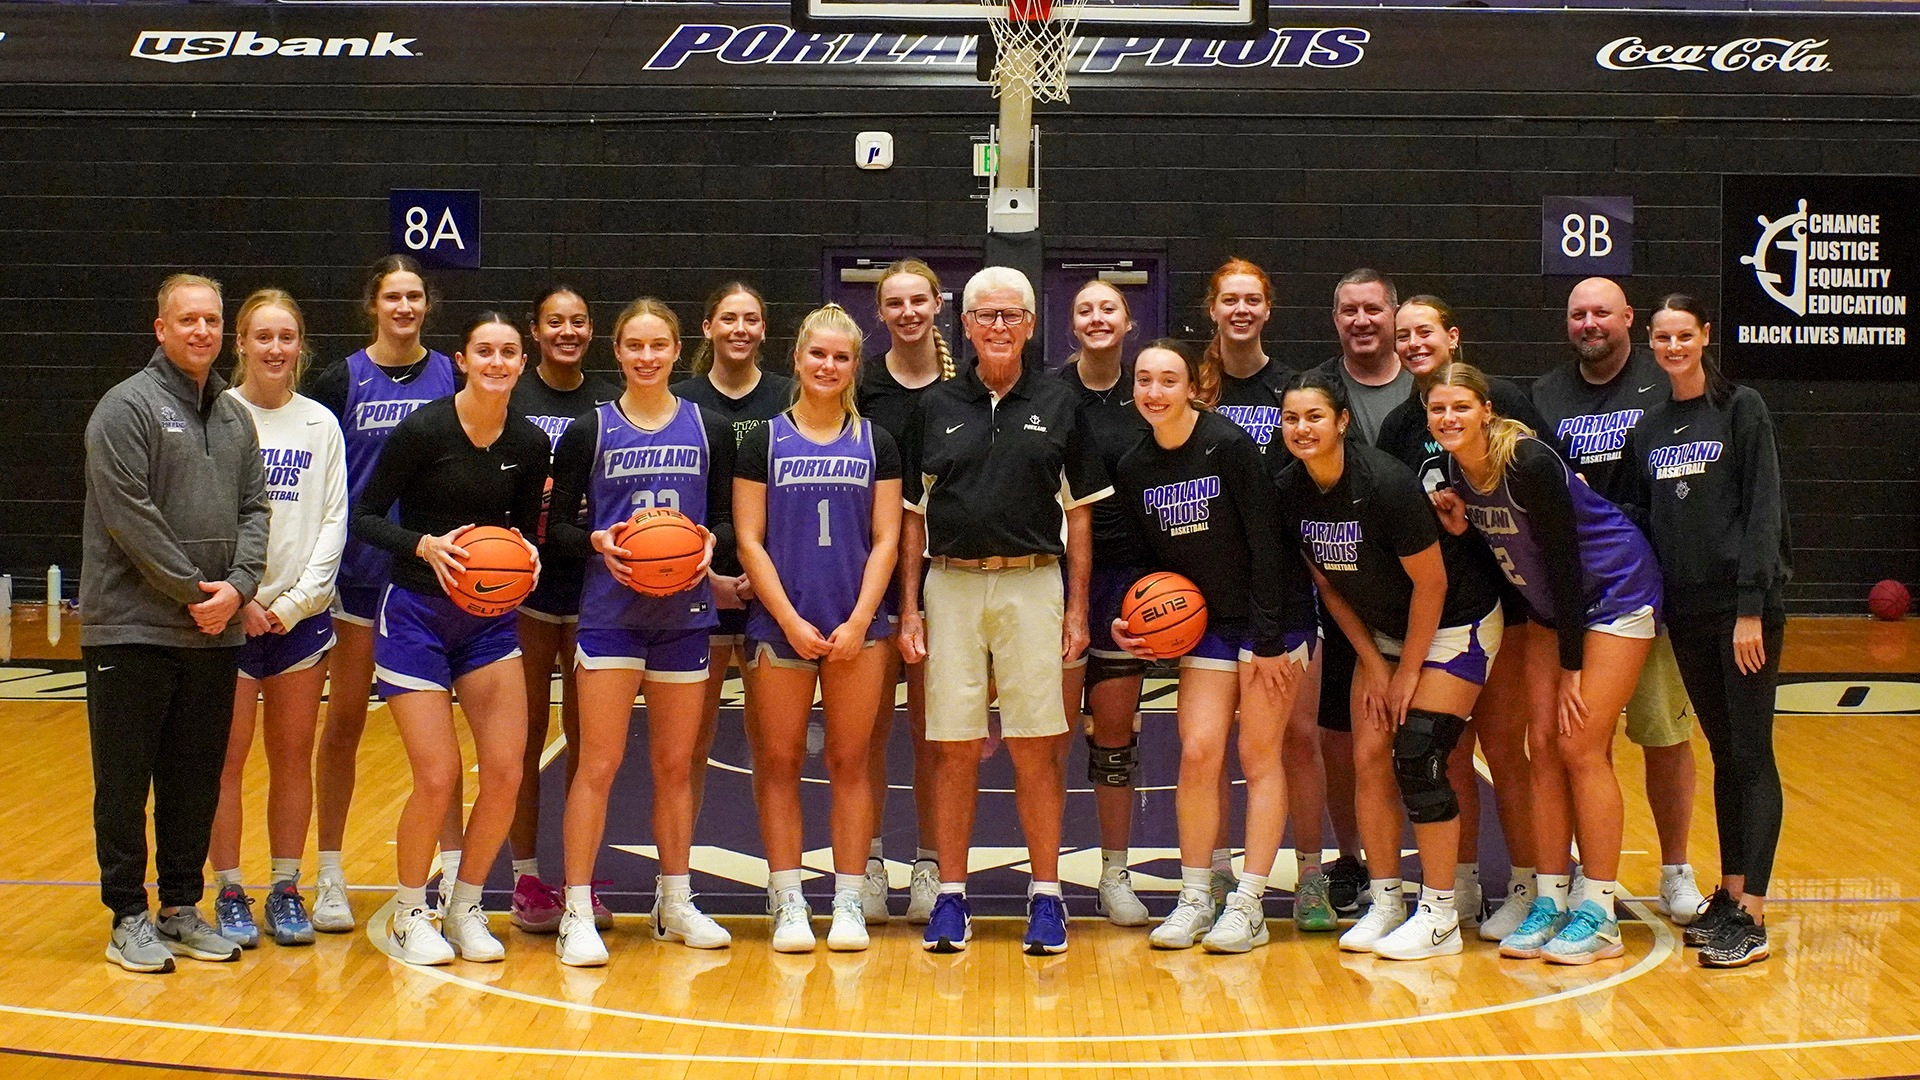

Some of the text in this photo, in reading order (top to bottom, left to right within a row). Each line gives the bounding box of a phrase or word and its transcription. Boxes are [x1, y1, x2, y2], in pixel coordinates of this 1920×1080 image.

[642, 24, 1370, 73] PORTLA PILOTS
[1596, 36, 1831, 72] Coca-Cola
[404, 206, 465, 250] 8A
[1561, 214, 1613, 257] 8B
[1809, 214, 1880, 234] CHANGE
[1808, 241, 1880, 261] JUSTICE
[1808, 268, 1891, 289] EQUALITY
[1808, 295, 1907, 315] EDUCATION
[1738, 325, 1906, 345] BLACK LIVES MATTER
[359, 402, 427, 427] PORT
[1557, 409, 1644, 440] PORTLAND
[1569, 428, 1627, 458] PILOTS
[261, 449, 313, 469] TLAND
[607, 449, 699, 476] PORTLAND
[1580, 451, 1622, 464] BASKETBALL
[1648, 441, 1723, 475] PORTLAND
[777, 459, 868, 483] PORTLAND
[1656, 462, 1706, 480] BASKETBALL
[266, 490, 299, 501] KETBALL
[1144, 475, 1220, 514] PORTLAND
[817, 499, 832, 546] 1
[1158, 498, 1209, 531] PILOTS
[1170, 522, 1209, 537] BASKETBALL
[1313, 542, 1358, 563] PILOTS
[1324, 562, 1358, 571] BASKETBALL
[1490, 545, 1527, 586] 2
[1141, 596, 1188, 623] ELITE
